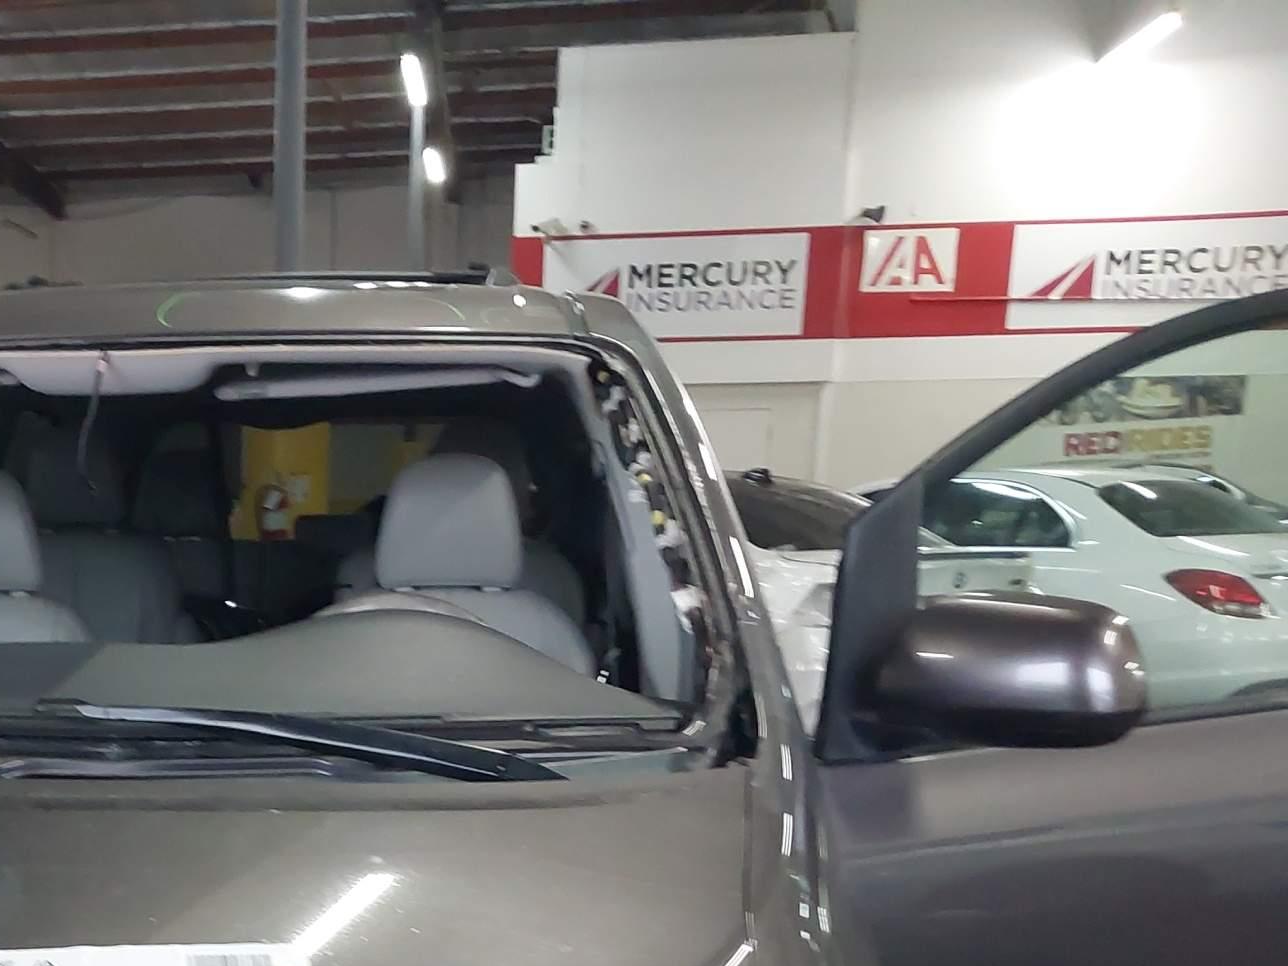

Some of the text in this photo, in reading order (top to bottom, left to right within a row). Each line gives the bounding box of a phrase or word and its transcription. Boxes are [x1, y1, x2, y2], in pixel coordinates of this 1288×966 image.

[628, 259, 798, 289] MERCURY
[1106, 245, 1288, 276] MERCURY
[625, 288, 797, 313] INSURANCE
